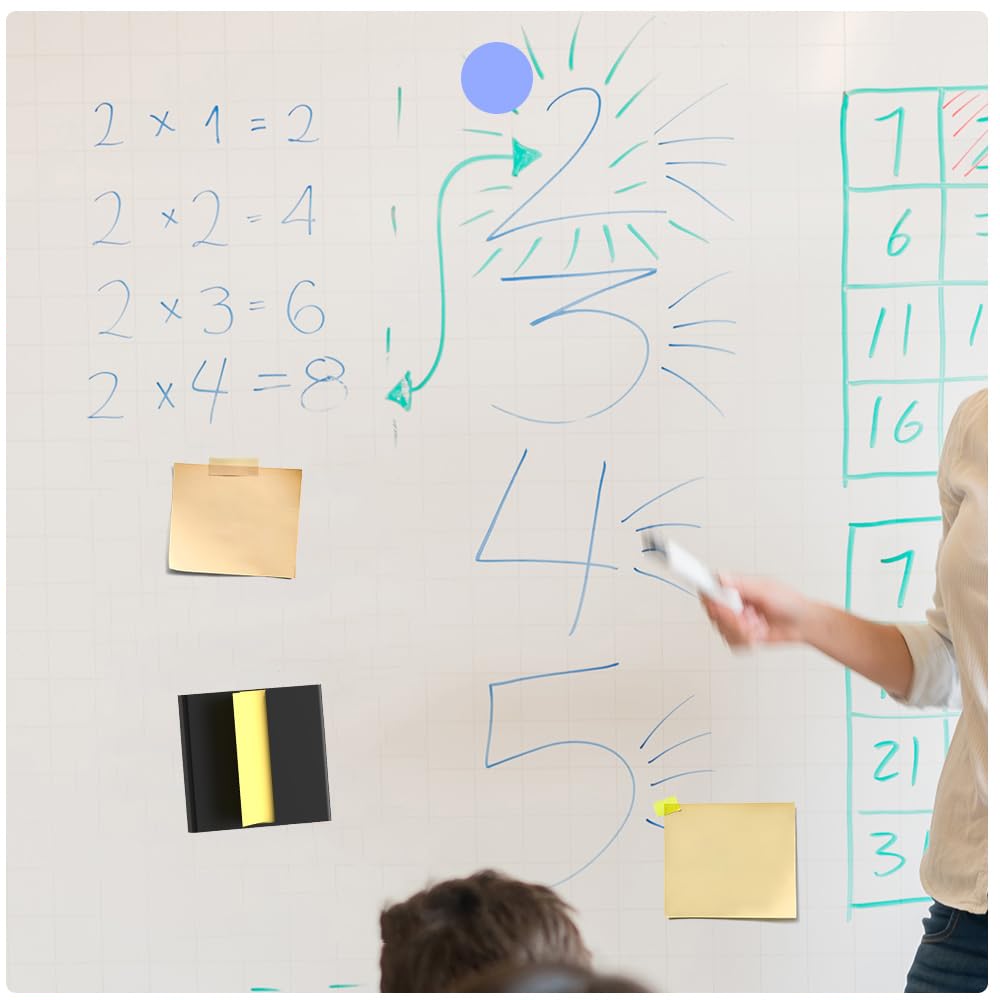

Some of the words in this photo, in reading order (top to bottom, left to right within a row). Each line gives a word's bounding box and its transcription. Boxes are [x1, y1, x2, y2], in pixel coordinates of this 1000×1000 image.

[94, 102, 125, 148] 2
[204, 104, 221, 144] 1
[287, 103, 320, 143] 2
[485, 87, 667, 242] 2
[92, 190, 131, 247] 2
[191, 189, 229, 248] 2
[281, 184, 317, 236] 4
[886, 207, 912, 257] 6
[98, 279, 134, 339] 2
[200, 286, 234, 335] 3
[287, 279, 326, 335] 6
[87, 371, 125, 419] 2
[191, 357, 229, 425] 4
[300, 355, 349, 413] 8
[869, 395, 924, 449] 16
[475, 447, 619, 637] 4
[485, 662, 636, 888] 5
[873, 735, 920, 787] 21
